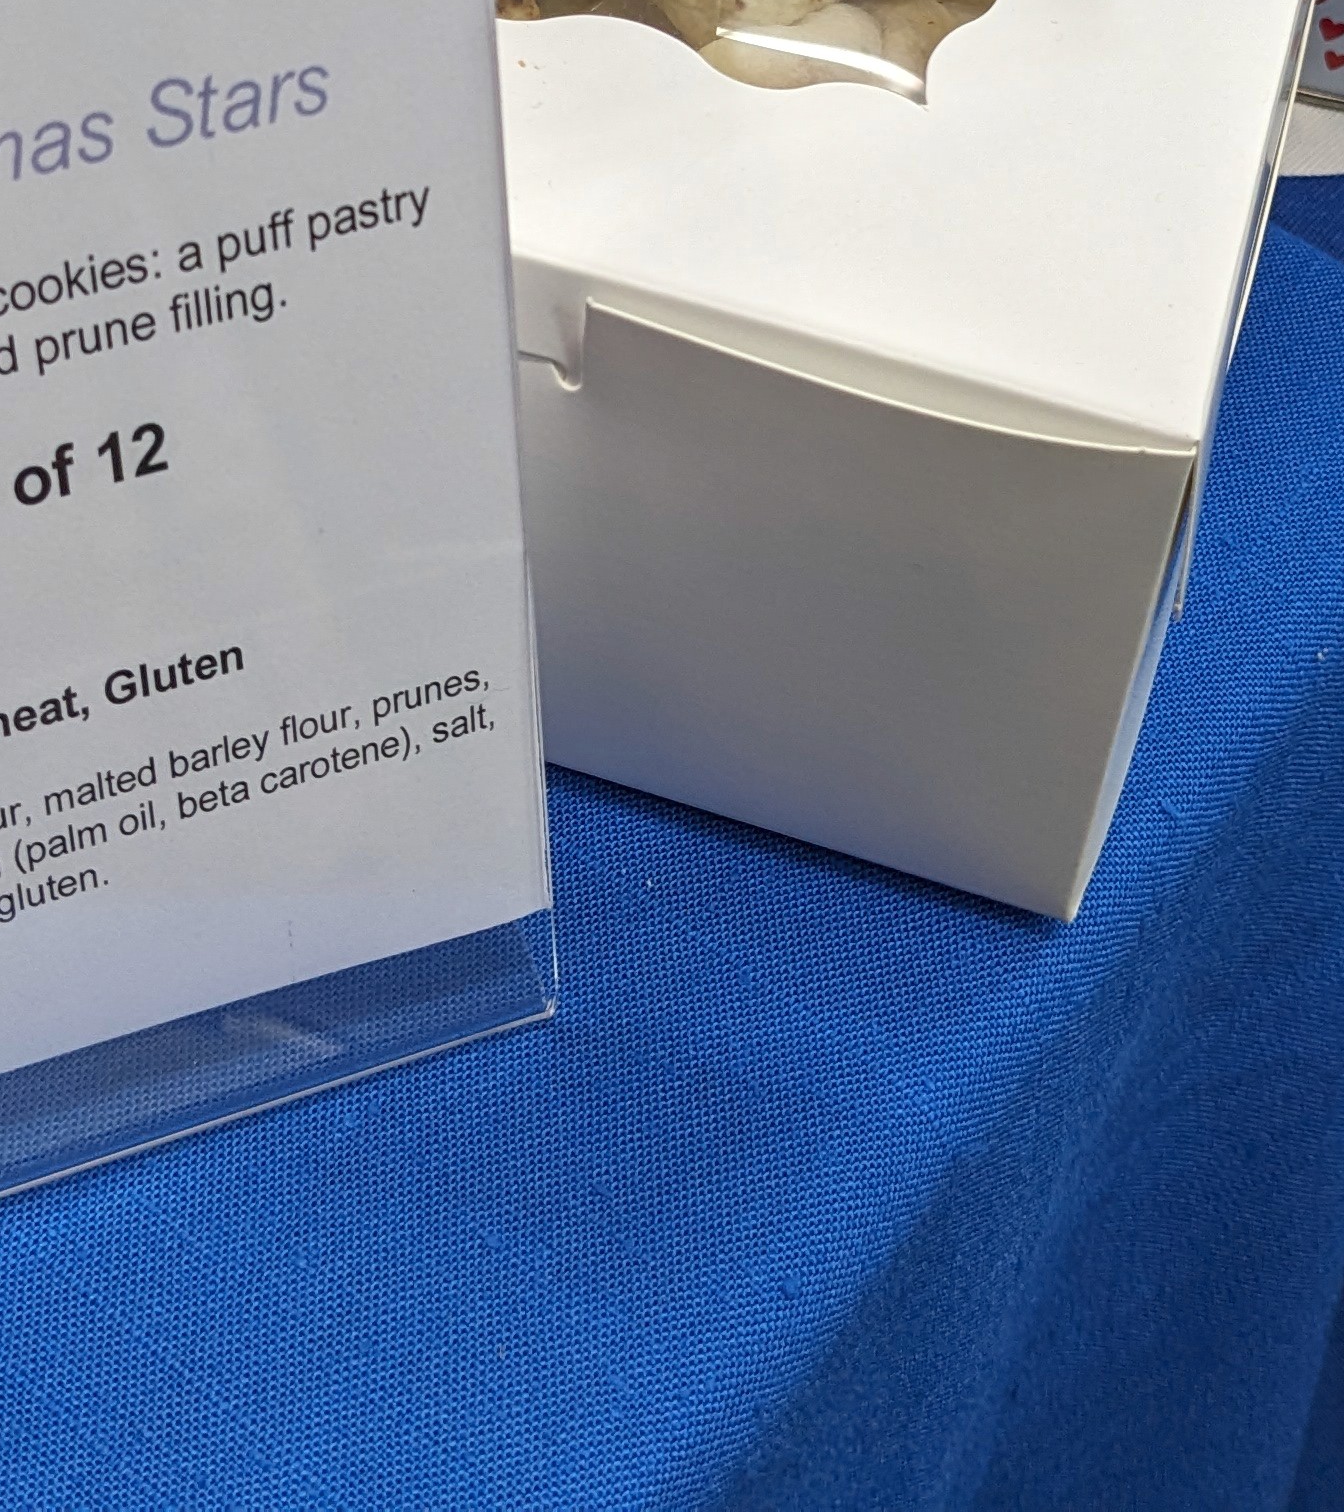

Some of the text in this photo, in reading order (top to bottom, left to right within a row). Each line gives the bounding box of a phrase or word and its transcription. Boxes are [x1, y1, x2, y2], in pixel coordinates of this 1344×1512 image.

[146, 64, 330, 149] Stars
[177, 240, 204, 273] a
[216, 207, 295, 274] puff
[307, 185, 431, 253] pastry
[34, 311, 157, 377] prune
[168, 281, 287, 334] filling.
[13, 441, 75, 506] of
[96, 422, 169, 484] 12
[104, 646, 245, 705] Gluten
[43, 755, 158, 817] malted
[168, 729, 270, 779] barley
[279, 705, 360, 746] flour,
[372, 669, 490, 727] prunes,
[14, 822, 108, 875] (palm
[118, 799, 166, 836] oil,
[177, 780, 251, 820] beta
[260, 725, 421, 795] carotene),
[432, 703, 495, 744] salt,
